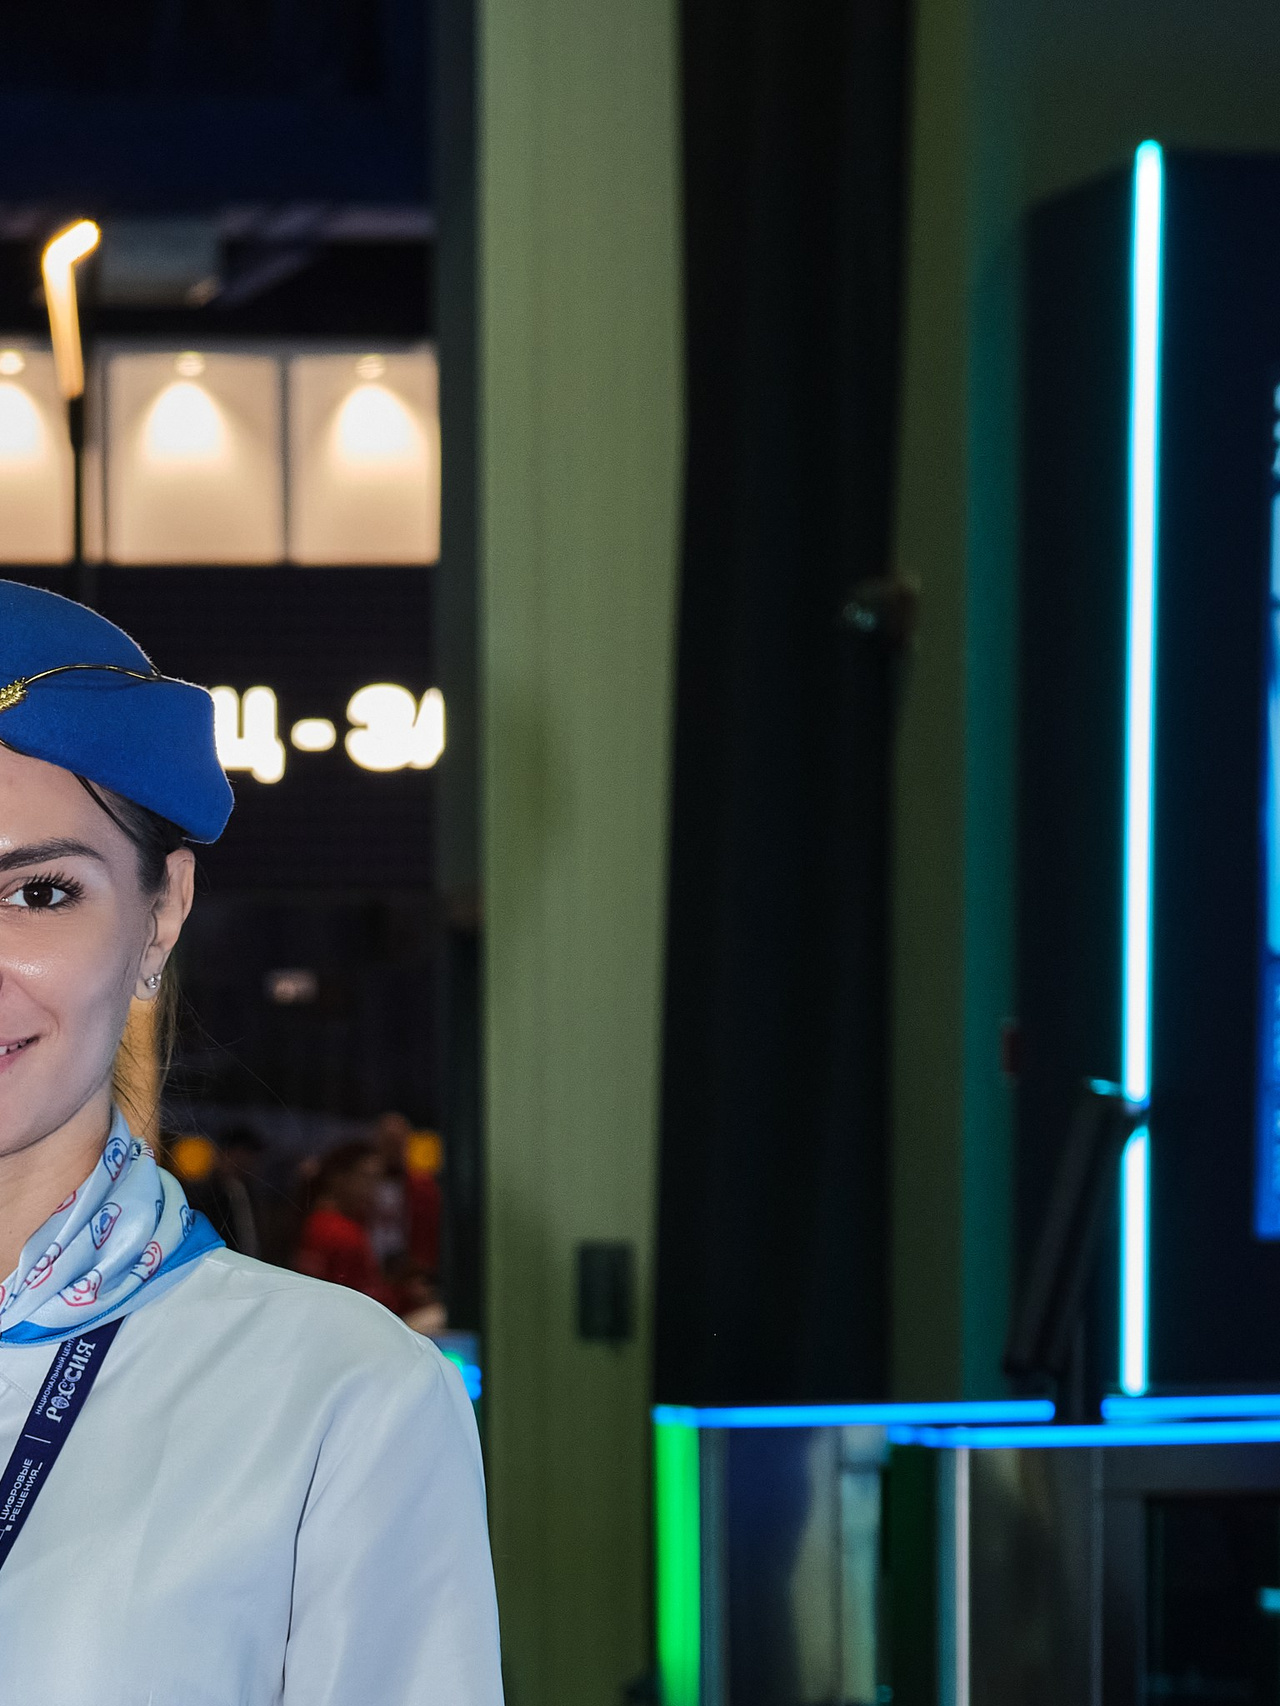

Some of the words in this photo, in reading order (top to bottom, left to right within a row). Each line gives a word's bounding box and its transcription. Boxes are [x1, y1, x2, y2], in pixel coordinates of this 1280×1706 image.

[35, 1356, 65, 1415] НАЦИОНАЛЬНЫЙ
[46, 1338, 96, 1423] РОССИЯ
[0, 1458, 33, 1520] ЦИФРОВЫЕ
